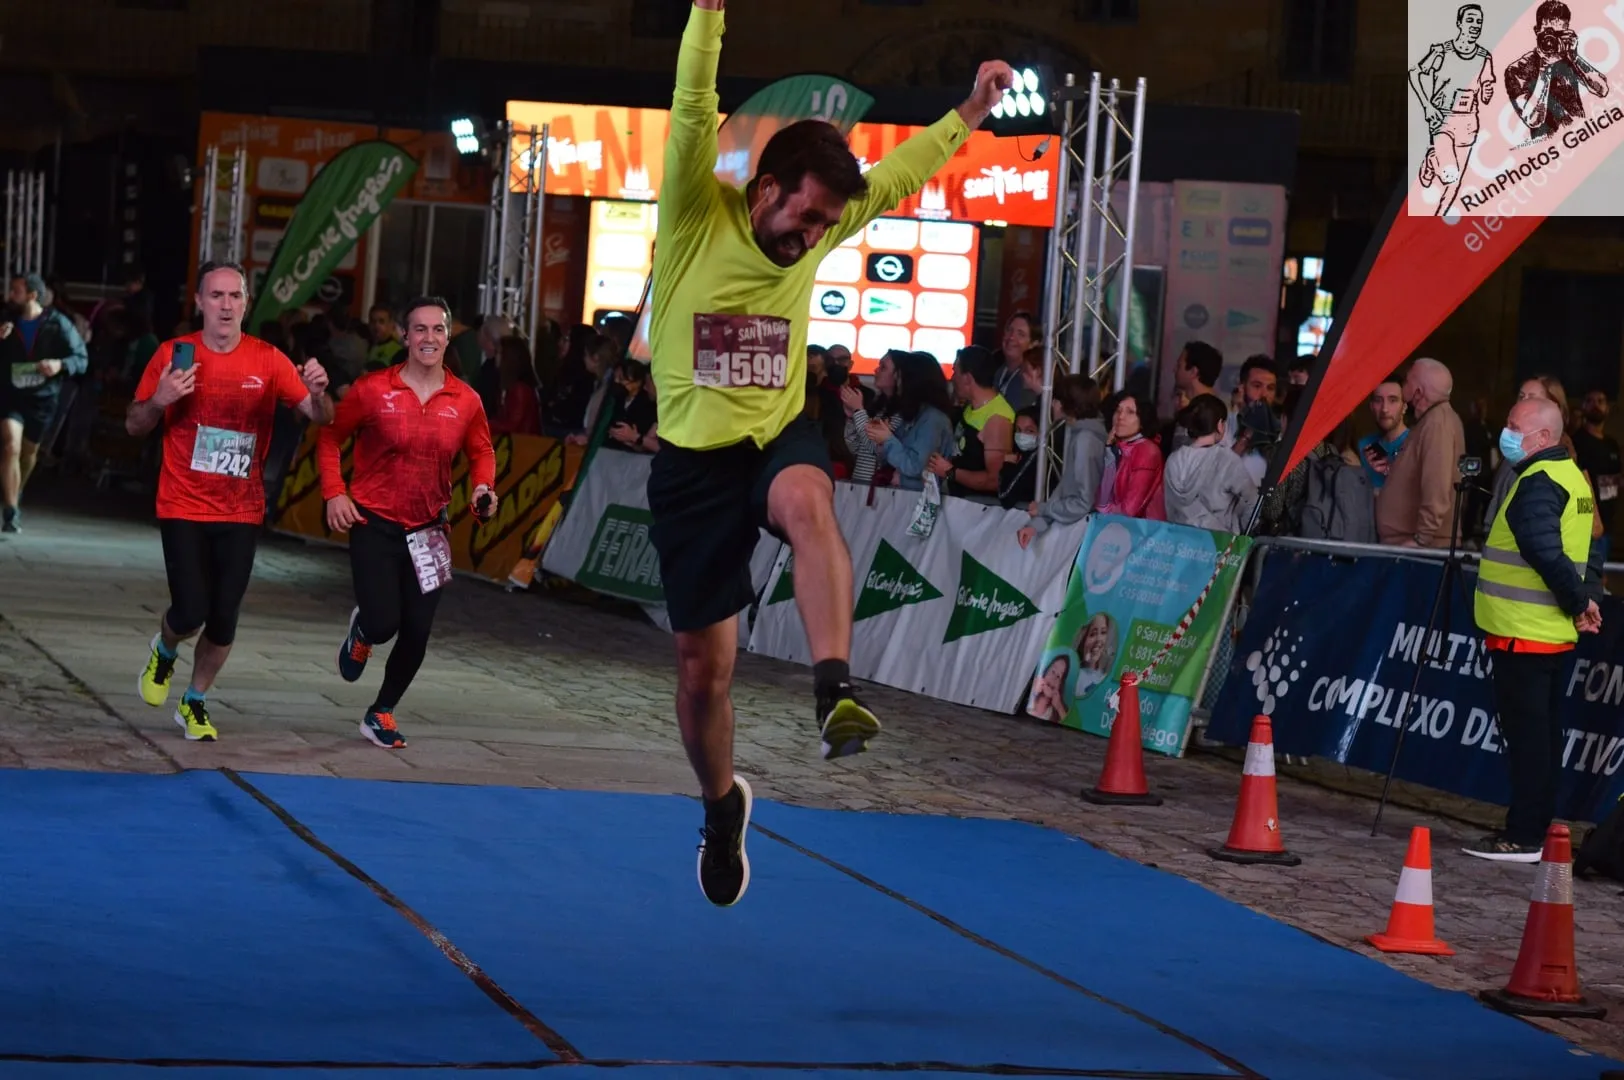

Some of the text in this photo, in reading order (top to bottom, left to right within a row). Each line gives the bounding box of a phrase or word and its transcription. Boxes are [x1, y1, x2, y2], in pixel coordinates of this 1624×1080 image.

[272, 276, 300, 304] El
[294, 226, 342, 281] Corte
[333, 155, 403, 239] Inglés
[714, 351, 787, 387] 1599
[210, 451, 250, 477] 1242
[411, 543, 440, 592] 1445
[1141, 626, 1158, 642] San
[1307, 675, 1456, 739] COMPLEXO
